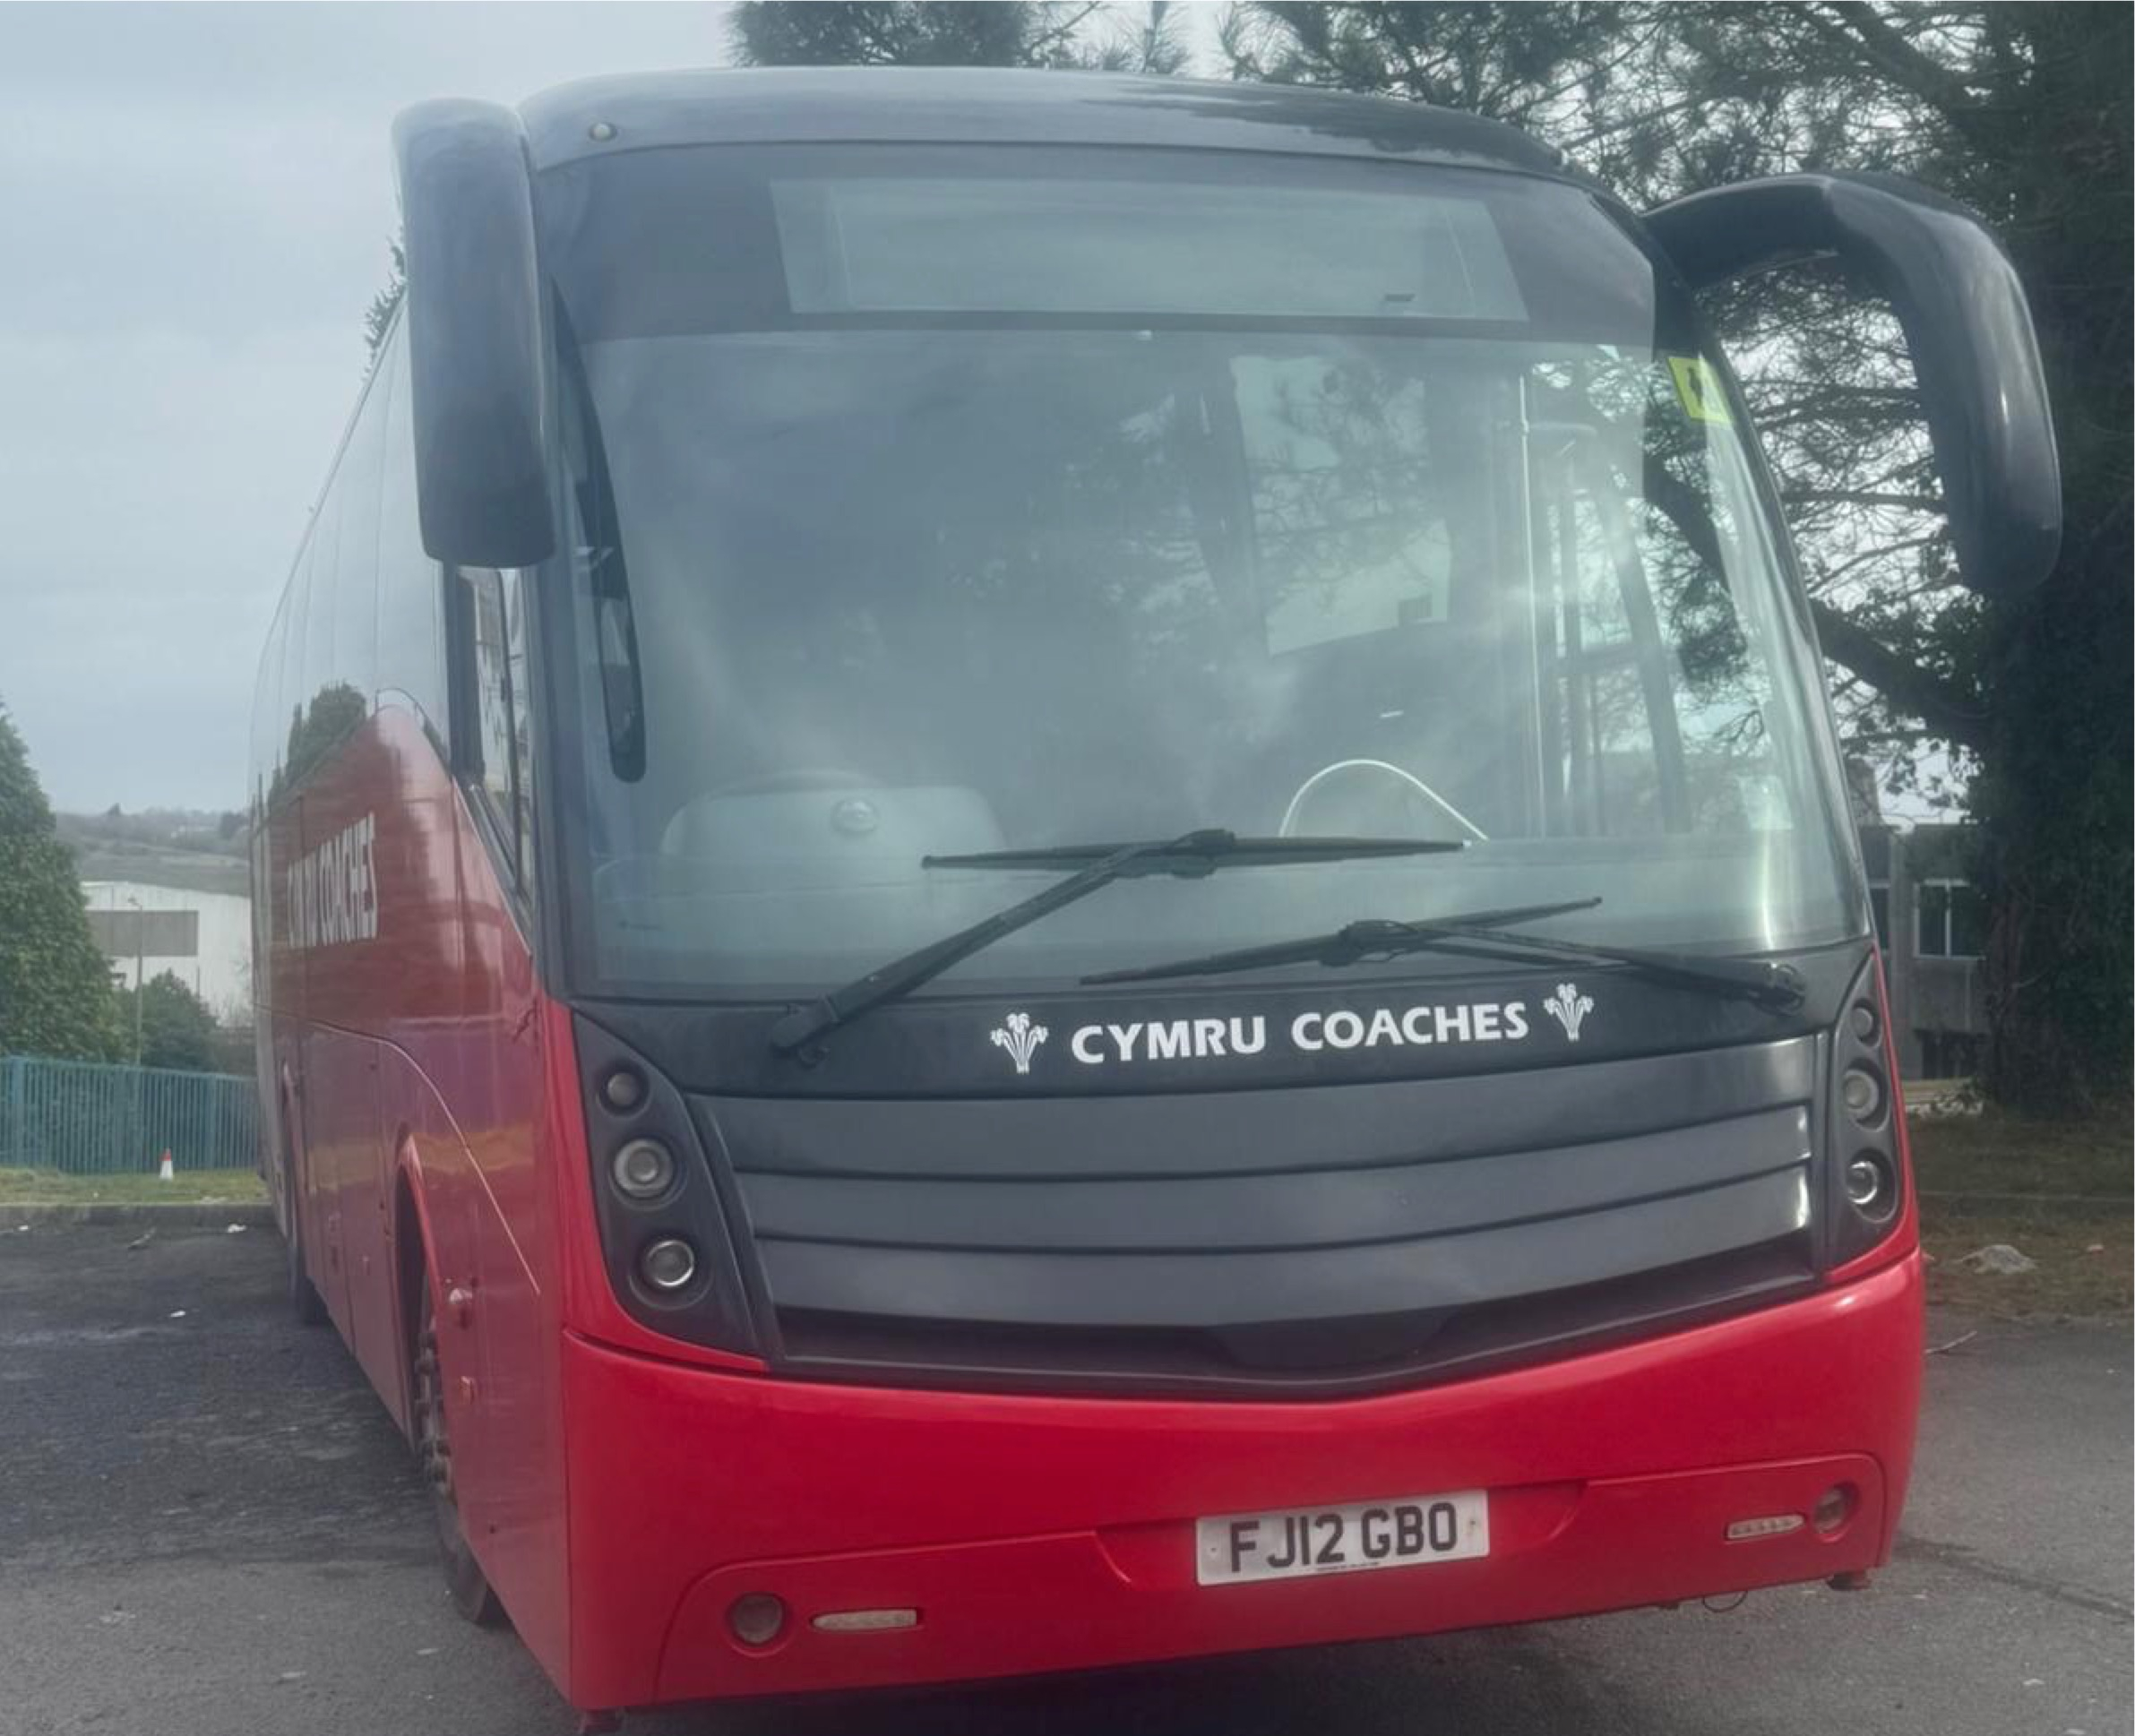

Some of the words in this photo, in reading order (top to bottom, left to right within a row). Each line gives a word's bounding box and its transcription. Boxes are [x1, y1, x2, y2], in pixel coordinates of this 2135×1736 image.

[319, 812, 378, 945] COACHES
[1072, 1015, 1266, 1063] CYMRU
[1291, 1001, 1528, 1050] COACHES
[1230, 1513, 1345, 1573] FJ12
[1361, 1501, 1457, 1559] GBO
